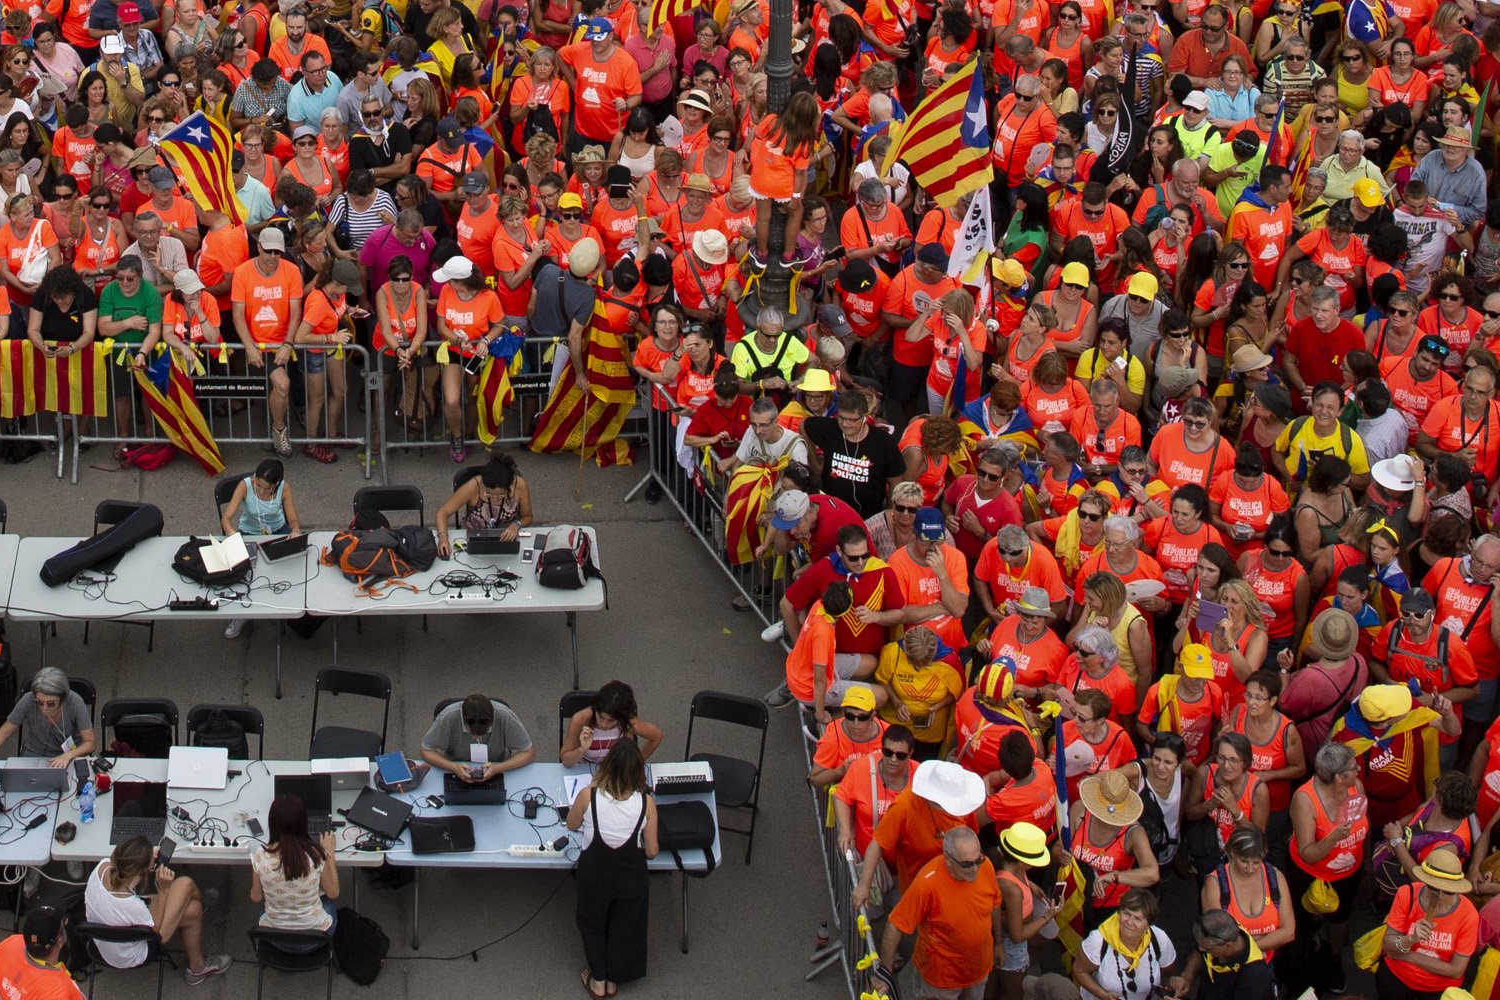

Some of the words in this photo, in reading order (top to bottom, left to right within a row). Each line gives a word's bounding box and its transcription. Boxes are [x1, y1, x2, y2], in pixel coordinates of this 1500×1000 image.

[833, 452, 870, 467] LLIBERTAT
[831, 468, 869, 483] POLÍTICS!
[832, 460, 869, 476] PRESOS
